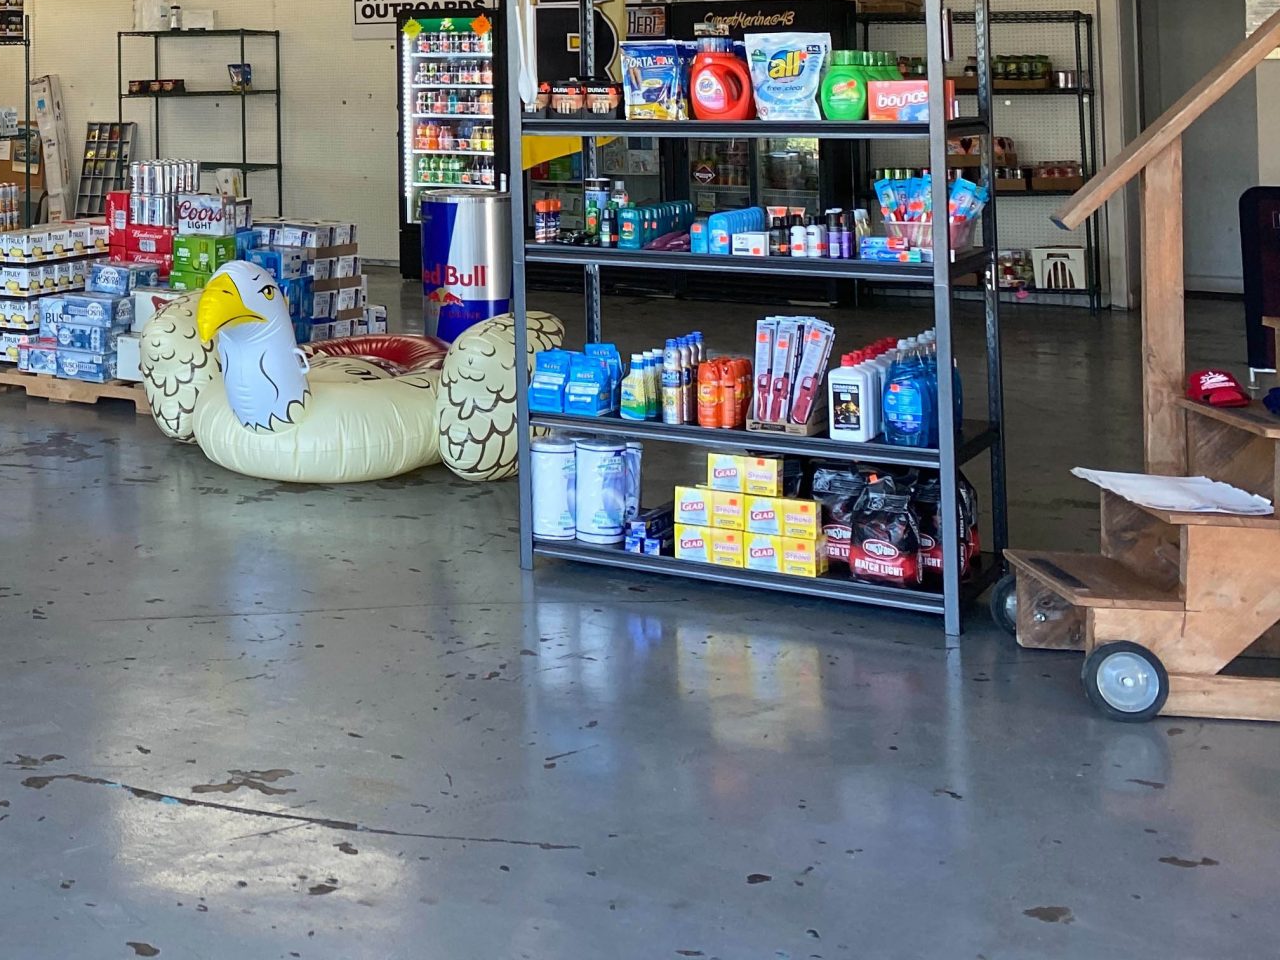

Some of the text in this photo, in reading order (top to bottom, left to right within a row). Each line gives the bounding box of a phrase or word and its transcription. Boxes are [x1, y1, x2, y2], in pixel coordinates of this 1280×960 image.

[769, 50, 801, 79] all
[877, 91, 928, 108] bounce
[179, 200, 224, 222] Coors
[187, 221, 211, 230] LIGHT
[132, 228, 162, 240] Budweiser
[134, 255, 164, 264] Budweiser
[423, 264, 486, 286] ed Bull
[9, 303, 26, 311] TRULY
[45, 312, 64, 324] BUS
[715, 469, 737, 477] GLAD
[682, 502, 704, 511] GLAD
[752, 512, 774, 520] GLAD
[824, 528, 852, 539] KINGSFOR
[681, 540, 703, 548] GLAD
[751, 549, 773, 557] GLAD
[826, 546, 841, 556] TCH
[881, 565, 904, 577] LIGHT
